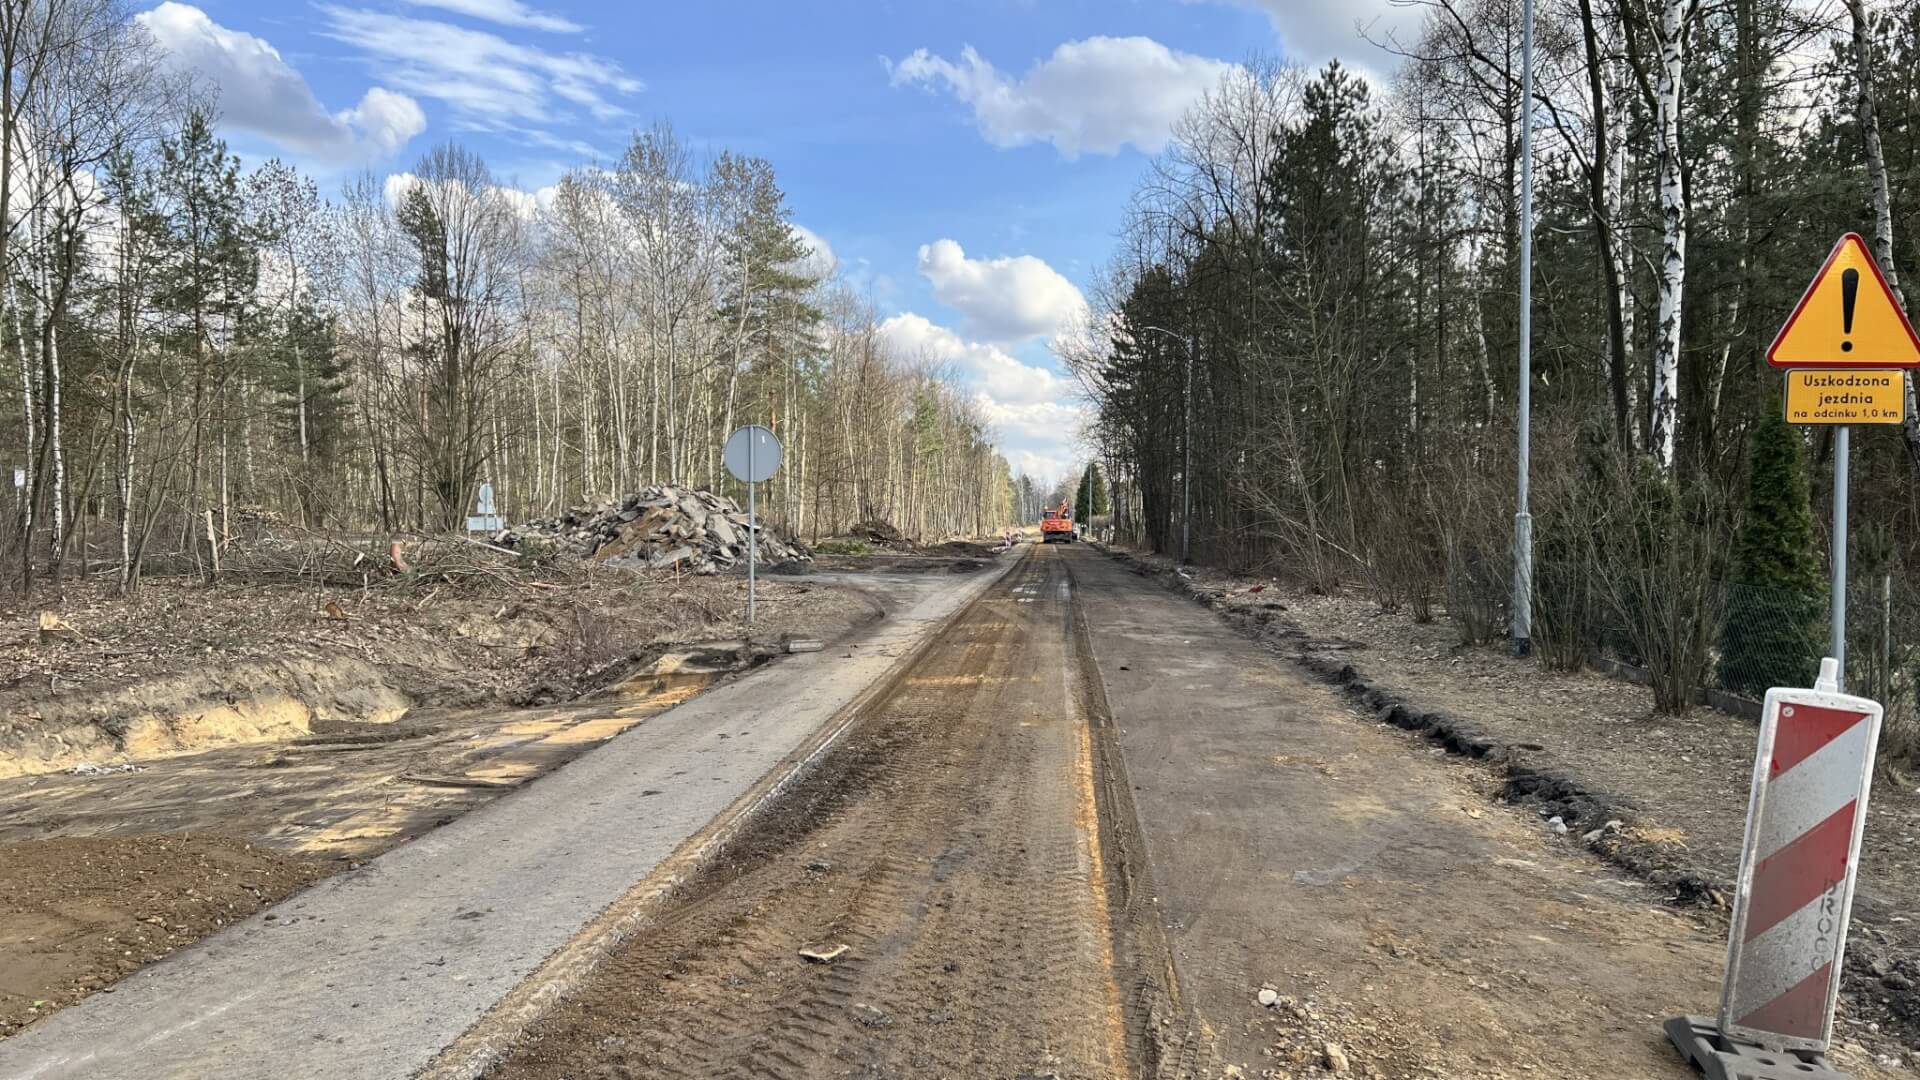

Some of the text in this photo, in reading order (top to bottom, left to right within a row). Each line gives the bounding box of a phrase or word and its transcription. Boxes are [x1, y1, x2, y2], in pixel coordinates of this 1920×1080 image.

[1804, 375, 1890, 387] Uszkodzona
[1818, 392, 1873, 407] jezdnia
[1793, 409, 1898, 418] na odcinku 1,0 km
